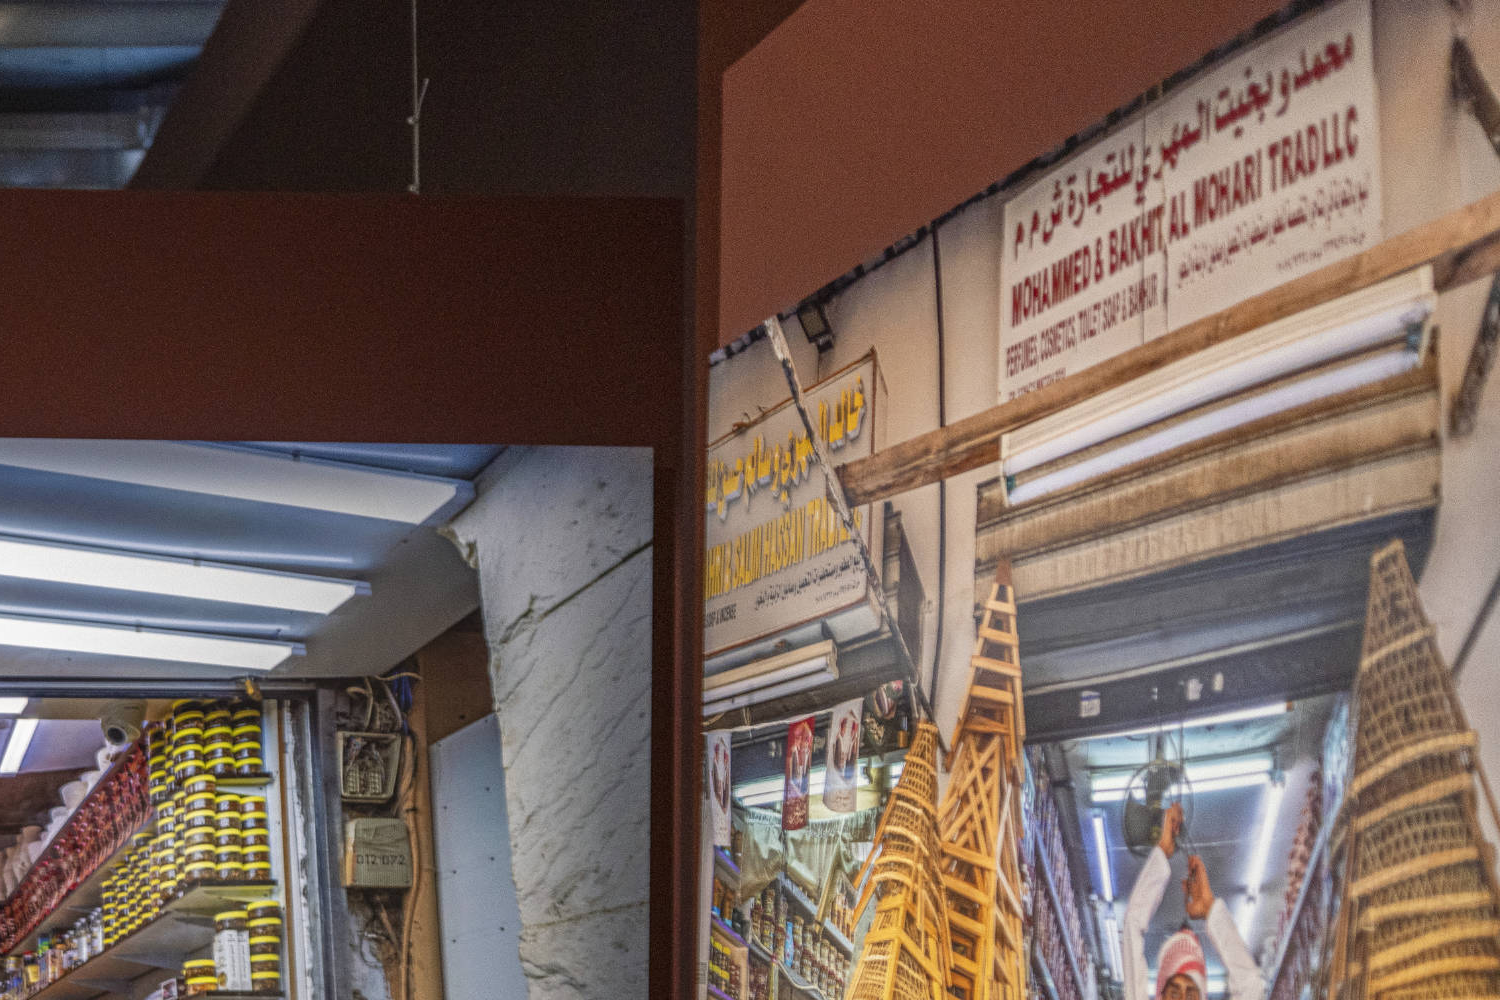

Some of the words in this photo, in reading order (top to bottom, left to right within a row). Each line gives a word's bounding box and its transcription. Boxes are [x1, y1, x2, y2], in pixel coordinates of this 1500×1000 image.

[1294, 33, 1355, 92] محمد
[1011, 244, 1092, 329] MOHAMMED
[1094, 236, 1105, 284] &
[1168, 190, 1190, 244] AL
[1193, 147, 1263, 230] MOHARI
[762, 504, 806, 577] HASSAN
